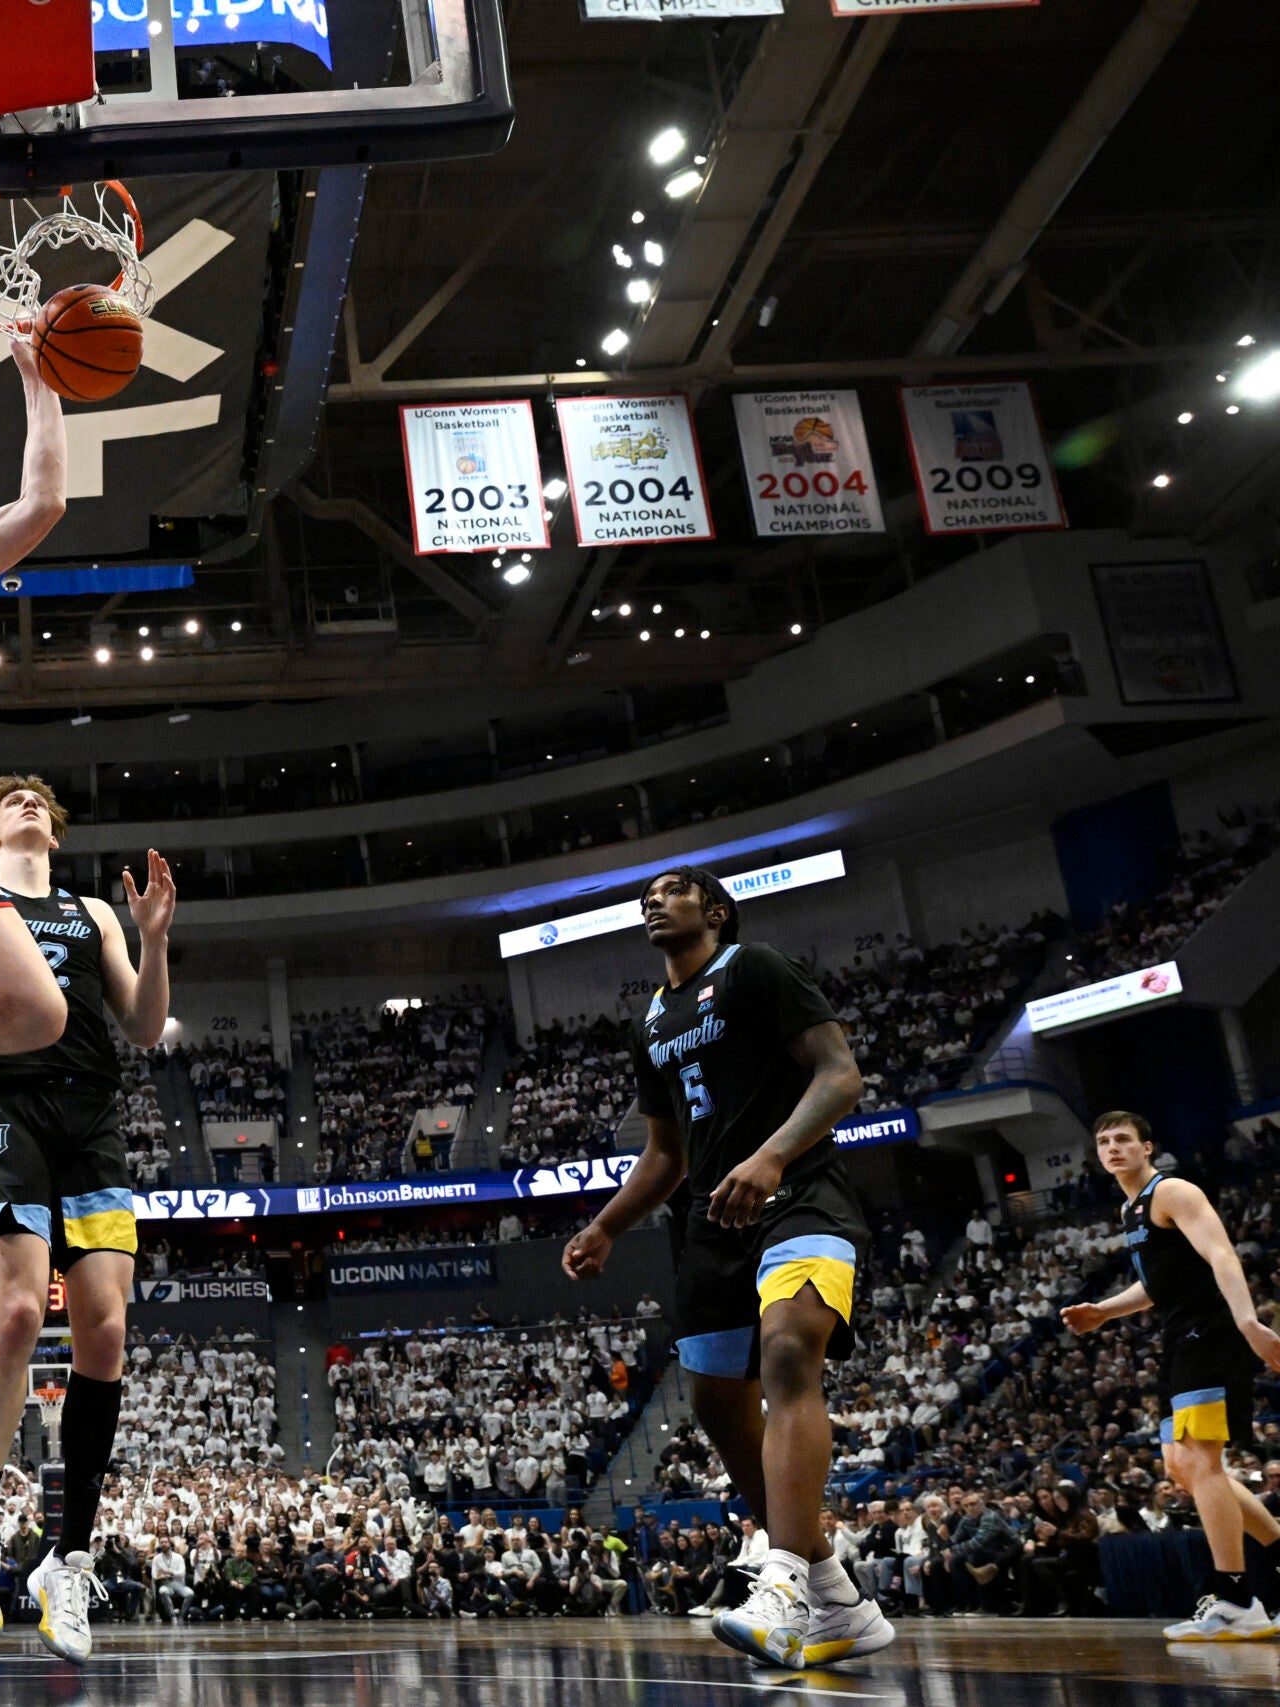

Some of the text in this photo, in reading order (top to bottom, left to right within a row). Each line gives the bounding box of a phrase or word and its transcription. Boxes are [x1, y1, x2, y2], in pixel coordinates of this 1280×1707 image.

[572, 398, 675, 411] UConn Women's
[754, 392, 836, 404] UConn Men's
[414, 406, 517, 419] UConn Women's
[593, 411, 658, 422] Basketball
[765, 405, 831, 416] Basketball
[435, 419, 500, 430] Basketball
[600, 424, 631, 434] NCAA
[757, 470, 868, 499] 2004
[929, 463, 1041, 493] 2009
[583, 476, 694, 506] 2004
[424, 484, 529, 514] 2003
[947, 495, 1036, 510] NATIONAL
[599, 508, 686, 523] NATIONAL
[774, 502, 861, 516] NATIONAL
[437, 516, 523, 530] NATIONAL
[769, 518, 871, 533] CHAMPIONS
[943, 511, 1048, 527] CHAMPIONS
[432, 532, 532, 546] CHAMPIONS
[594, 524, 696, 539] CHAMPIONS
[733, 869, 792, 892] UNITED
[622, 981, 649, 996] 228
[212, 1017, 238, 1030] 226
[648, 1013, 726, 1069] Marquette
[679, 1062, 716, 1122] 5
[1046, 1155, 1070, 1168] 124
[331, 1258, 491, 1284] UCONN NATIN
[180, 1281, 266, 1298] HUSKIES
